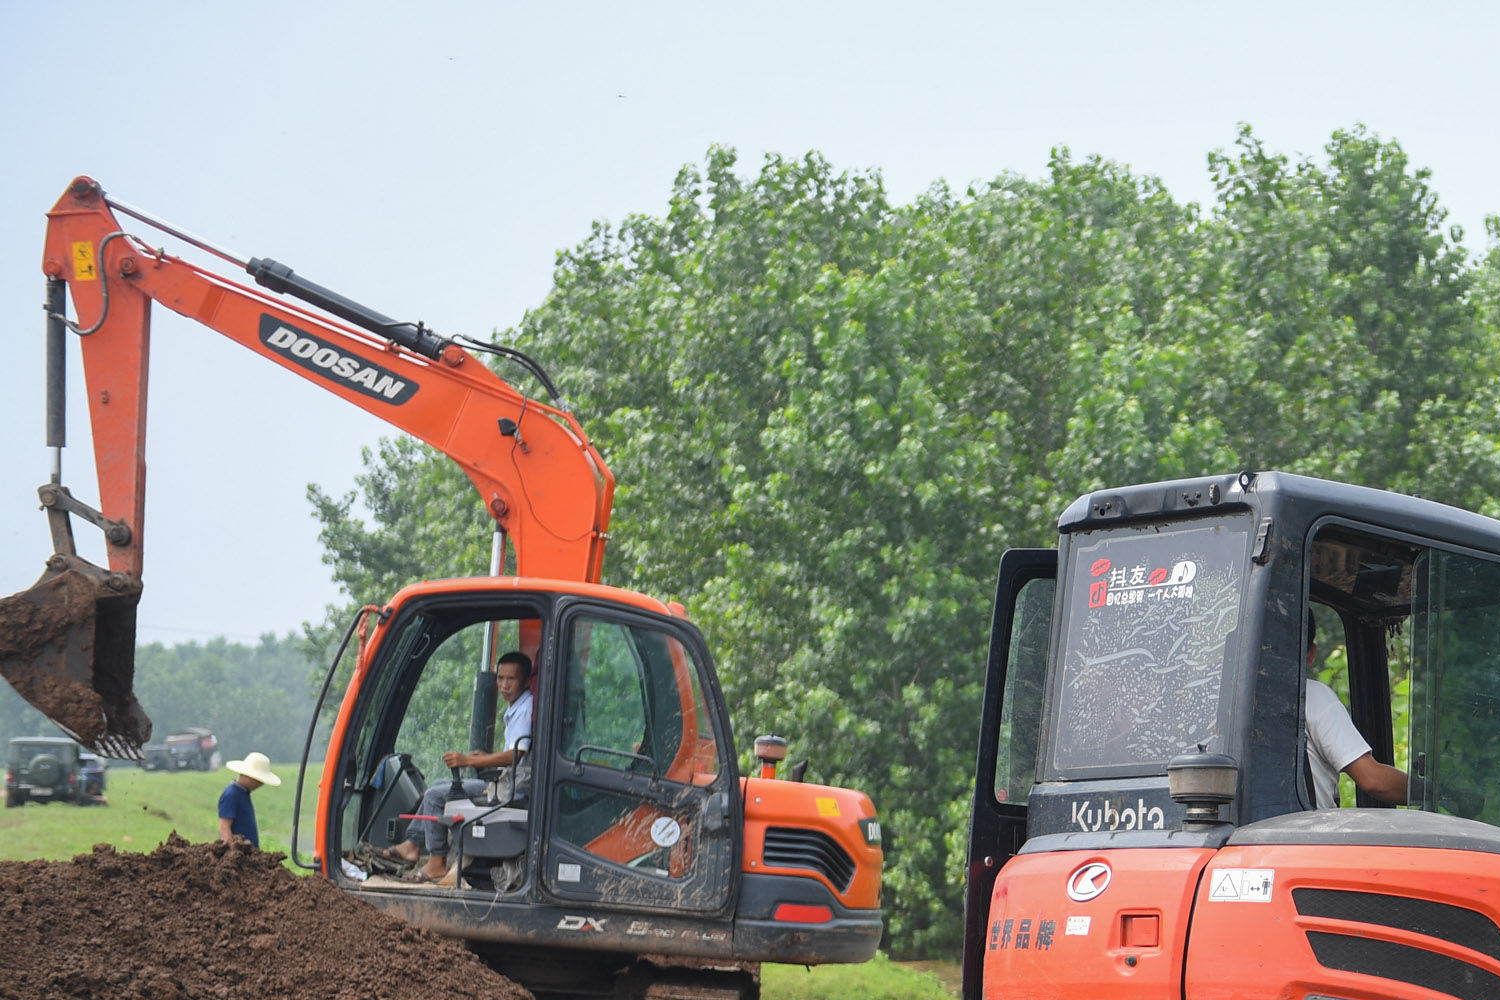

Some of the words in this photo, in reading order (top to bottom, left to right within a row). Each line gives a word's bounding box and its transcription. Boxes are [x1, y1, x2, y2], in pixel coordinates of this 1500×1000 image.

[267, 326, 405, 399] DOOSAN
[1109, 565, 1146, 588] 抖友
[1071, 798, 1164, 832] Kubota
[557, 915, 607, 932] DX
[990, 919, 1056, 950] 世界品牌
